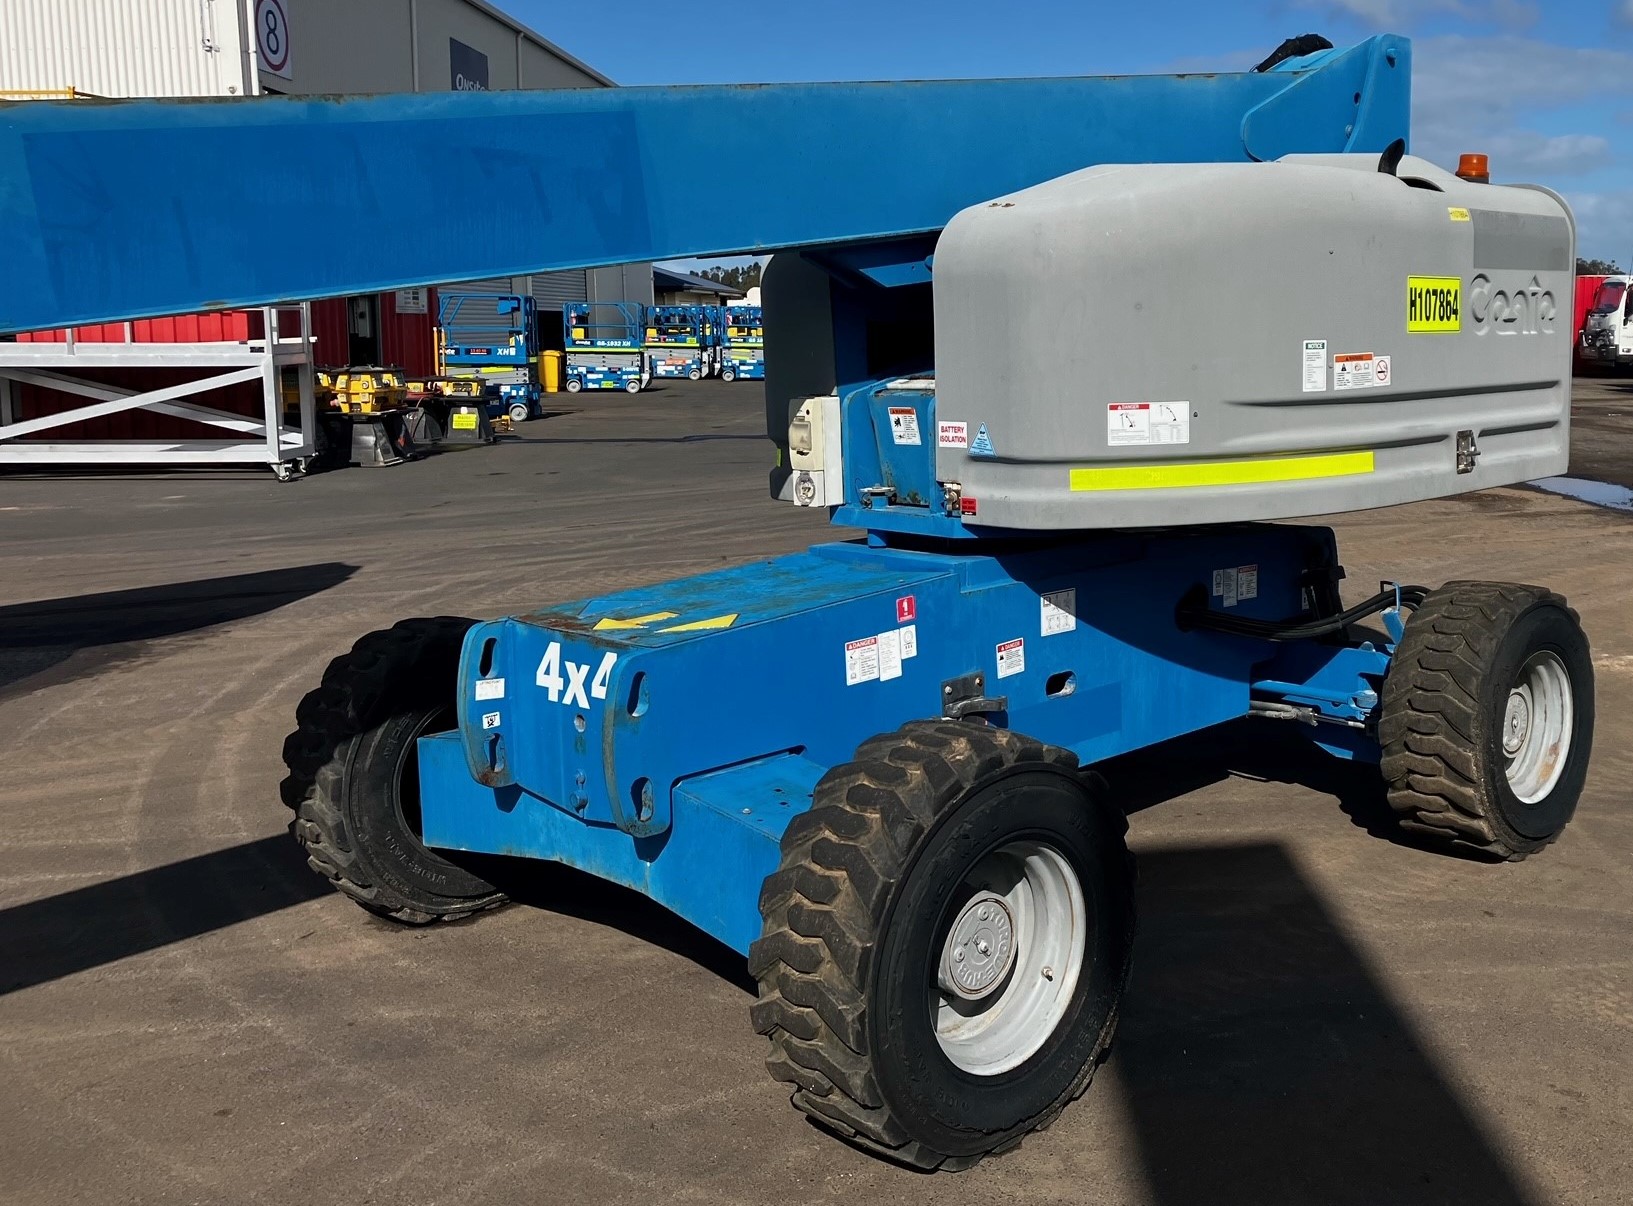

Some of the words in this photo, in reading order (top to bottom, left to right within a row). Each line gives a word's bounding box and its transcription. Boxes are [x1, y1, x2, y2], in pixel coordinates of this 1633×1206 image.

[265, 9, 280, 55] 8
[1409, 286, 1459, 322] H107864
[496, 347, 509, 356] XH
[940, 425, 965, 434] BATTERY
[939, 435, 967, 443] ISOLATION
[852, 637, 877, 649] DANGER
[535, 641, 618, 710] 4x4
